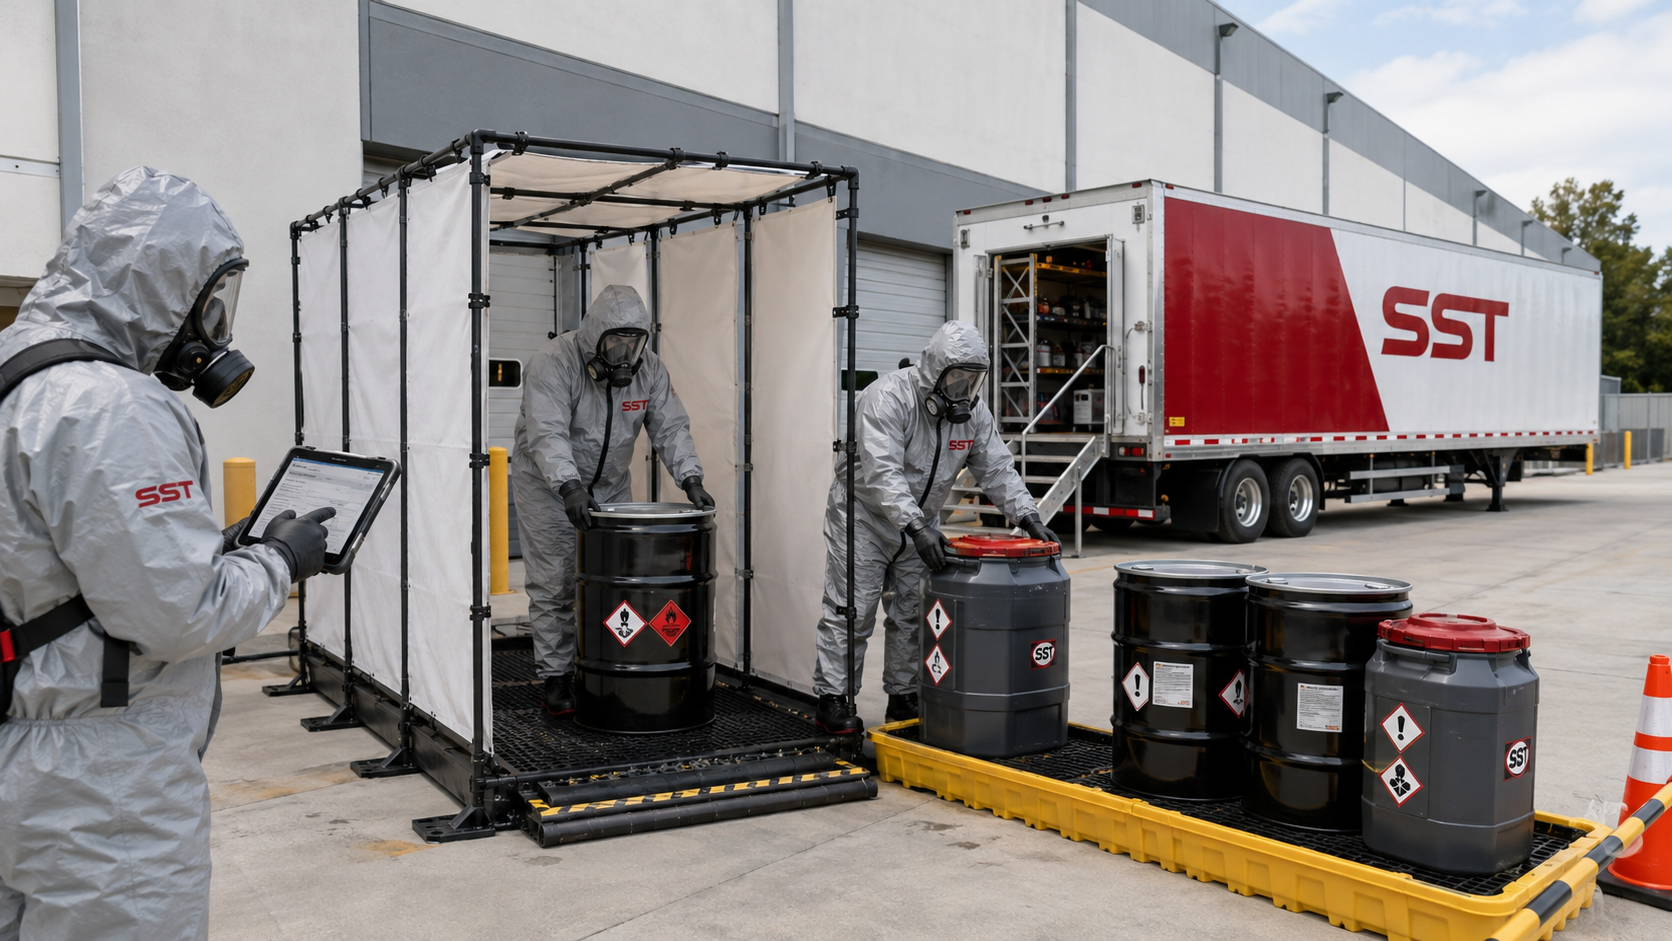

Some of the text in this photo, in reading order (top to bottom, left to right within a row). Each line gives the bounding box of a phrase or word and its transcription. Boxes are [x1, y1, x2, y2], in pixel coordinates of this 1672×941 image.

[1381, 286, 1509, 362] SST
[622, 399, 648, 412] SST
[948, 439, 975, 451] SST
[135, 480, 194, 508] SST
[1034, 646, 1053, 661] SST
[1509, 746, 1528, 769] SST
